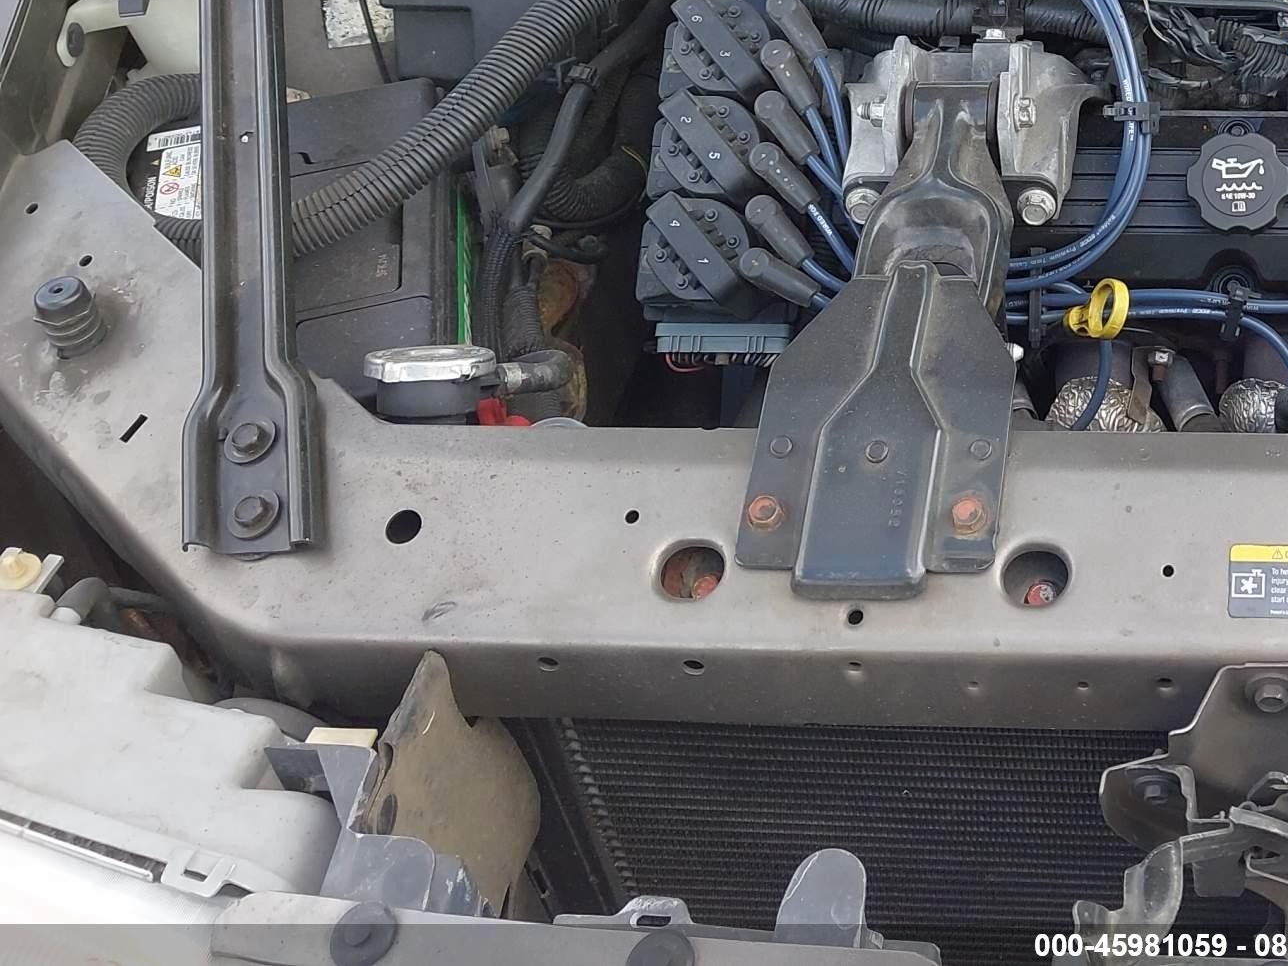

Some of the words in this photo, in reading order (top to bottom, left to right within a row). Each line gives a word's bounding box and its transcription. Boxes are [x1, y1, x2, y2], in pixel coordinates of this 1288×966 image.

[681, 116, 691, 124] 2
[709, 152, 720, 160] 5
[698, 257, 709, 265] 1
